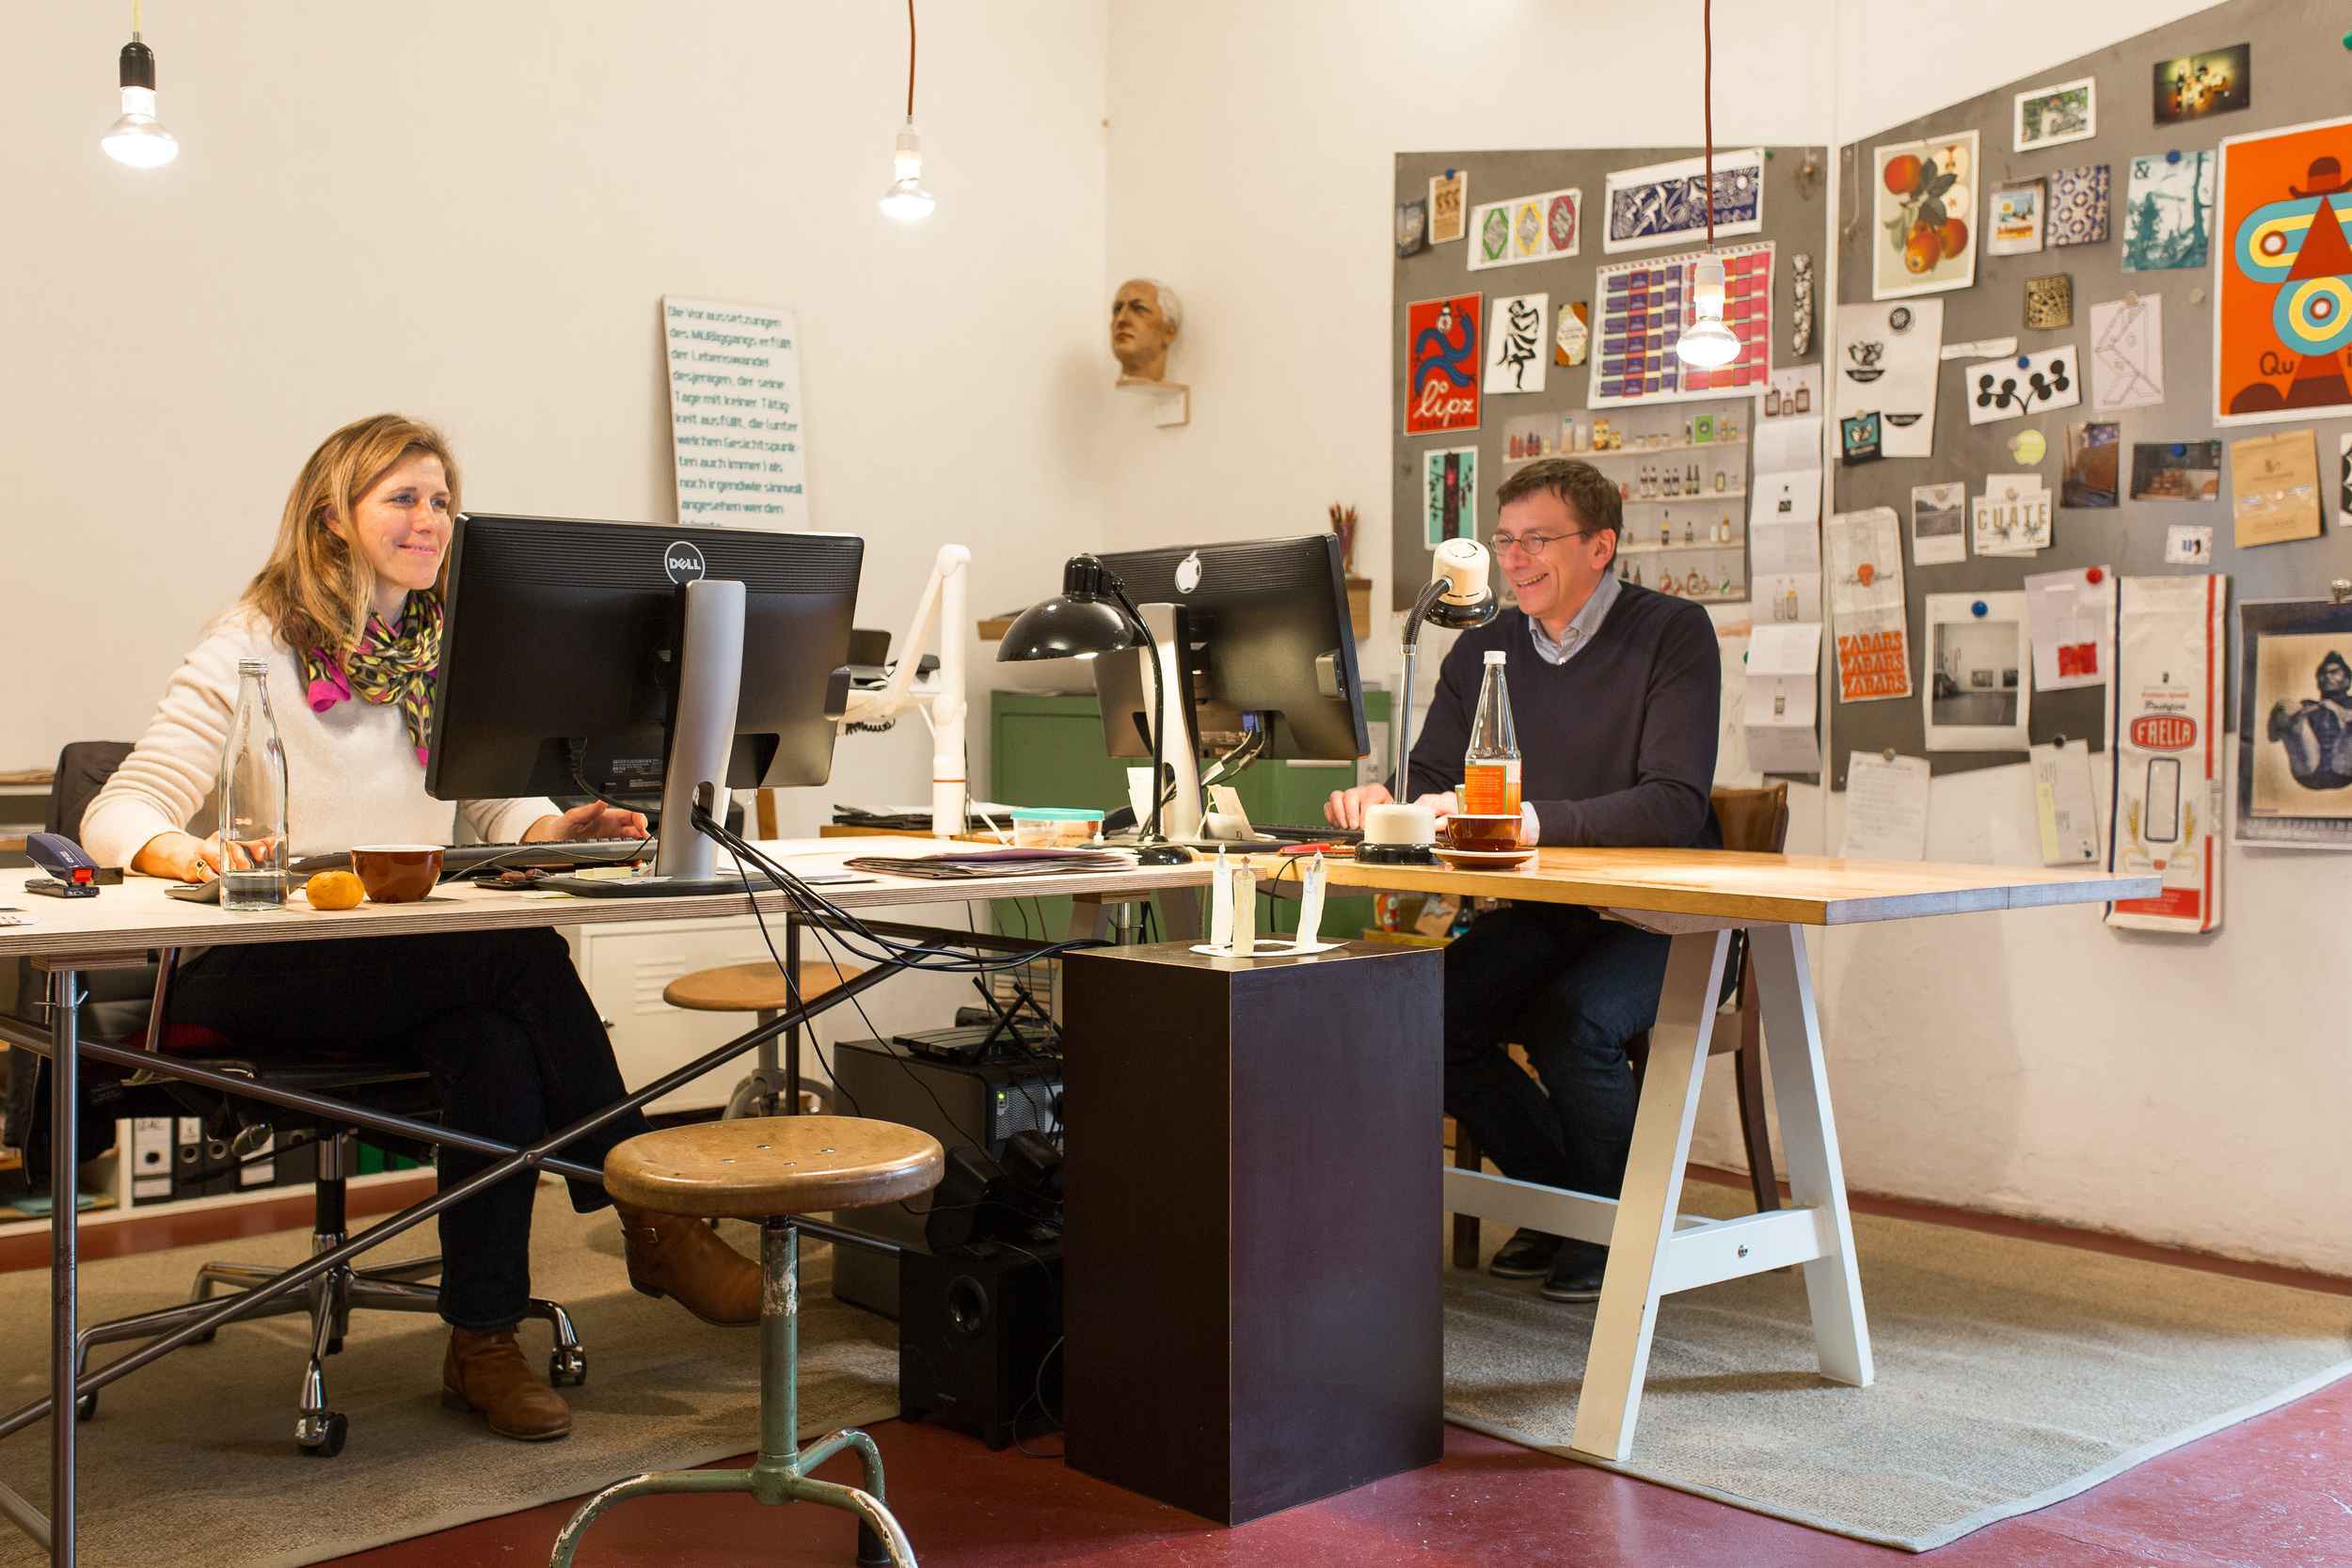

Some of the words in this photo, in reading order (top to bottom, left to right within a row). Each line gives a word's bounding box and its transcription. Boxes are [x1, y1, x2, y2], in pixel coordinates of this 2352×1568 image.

[1413, 379, 1474, 427] lipz
[669, 557, 702, 570] DELL
[2137, 720, 2192, 746] FAELLA
